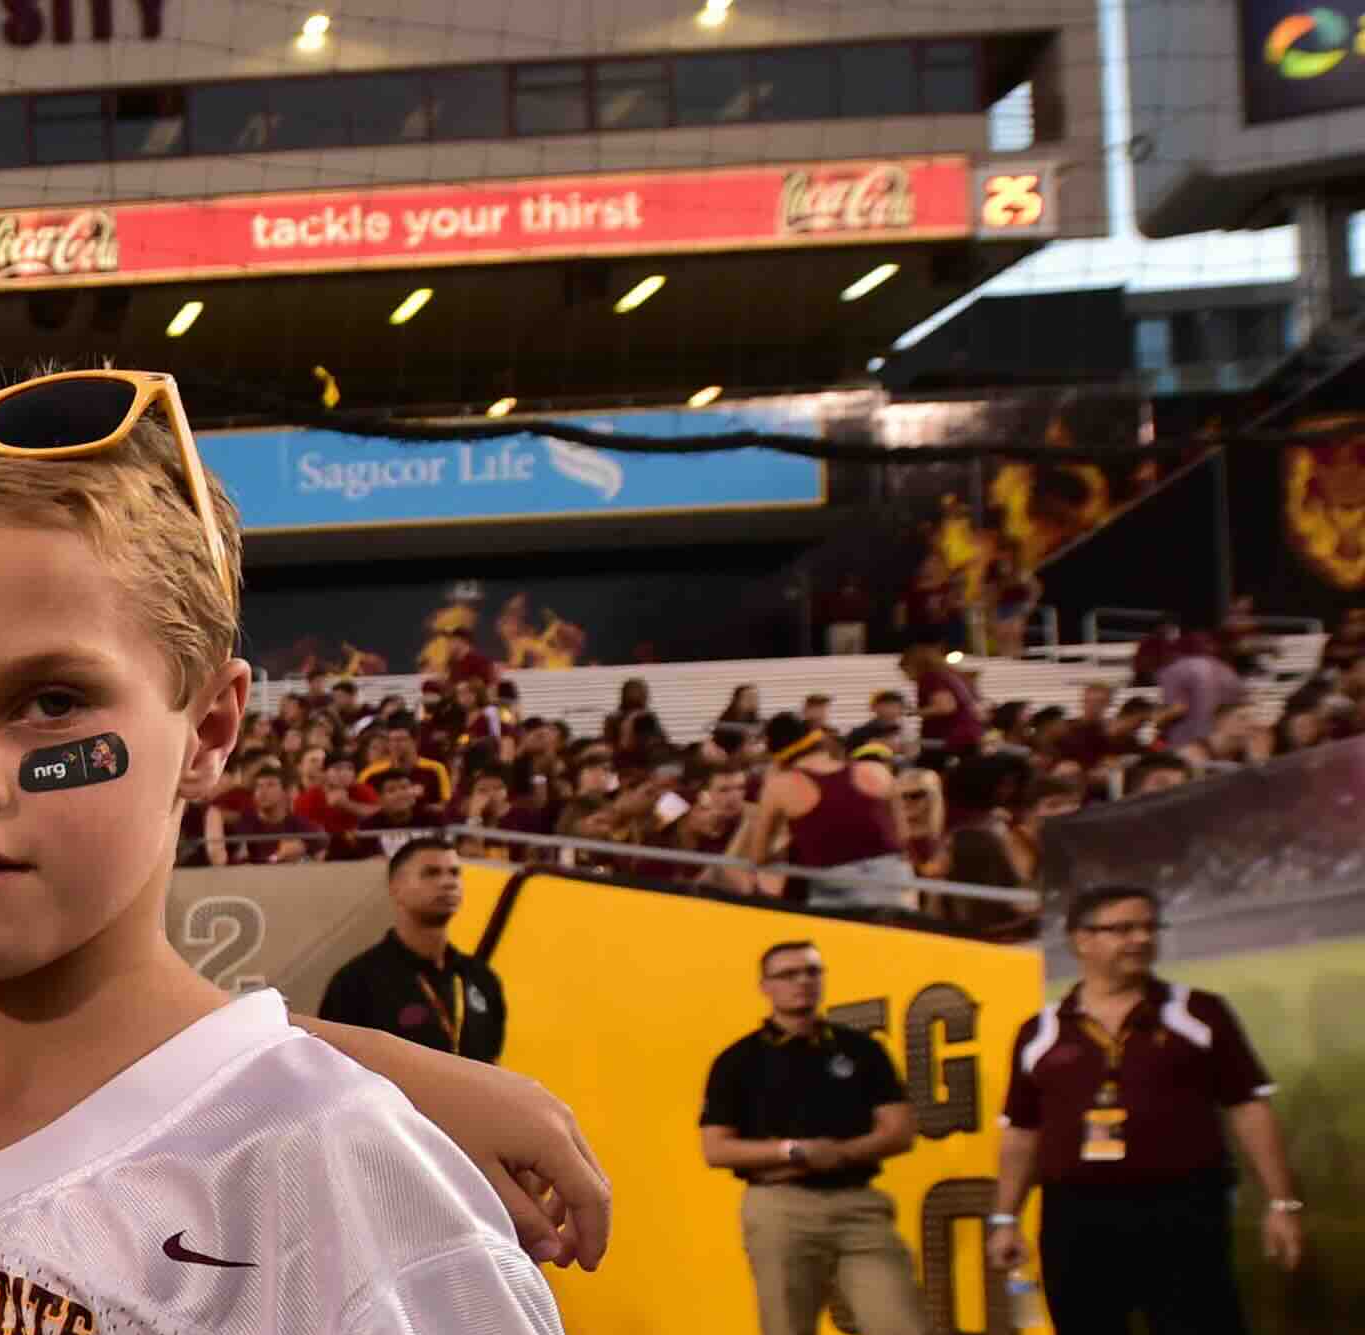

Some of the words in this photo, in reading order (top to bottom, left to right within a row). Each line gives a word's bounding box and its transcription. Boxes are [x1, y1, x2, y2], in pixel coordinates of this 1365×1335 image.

[251, 208, 391, 248] tackle
[403, 203, 509, 247] your
[521, 190, 642, 234] thirst
[297, 448, 447, 499] Sagicor
[456, 440, 536, 484] Life
[33, 761, 66, 780] nrg
